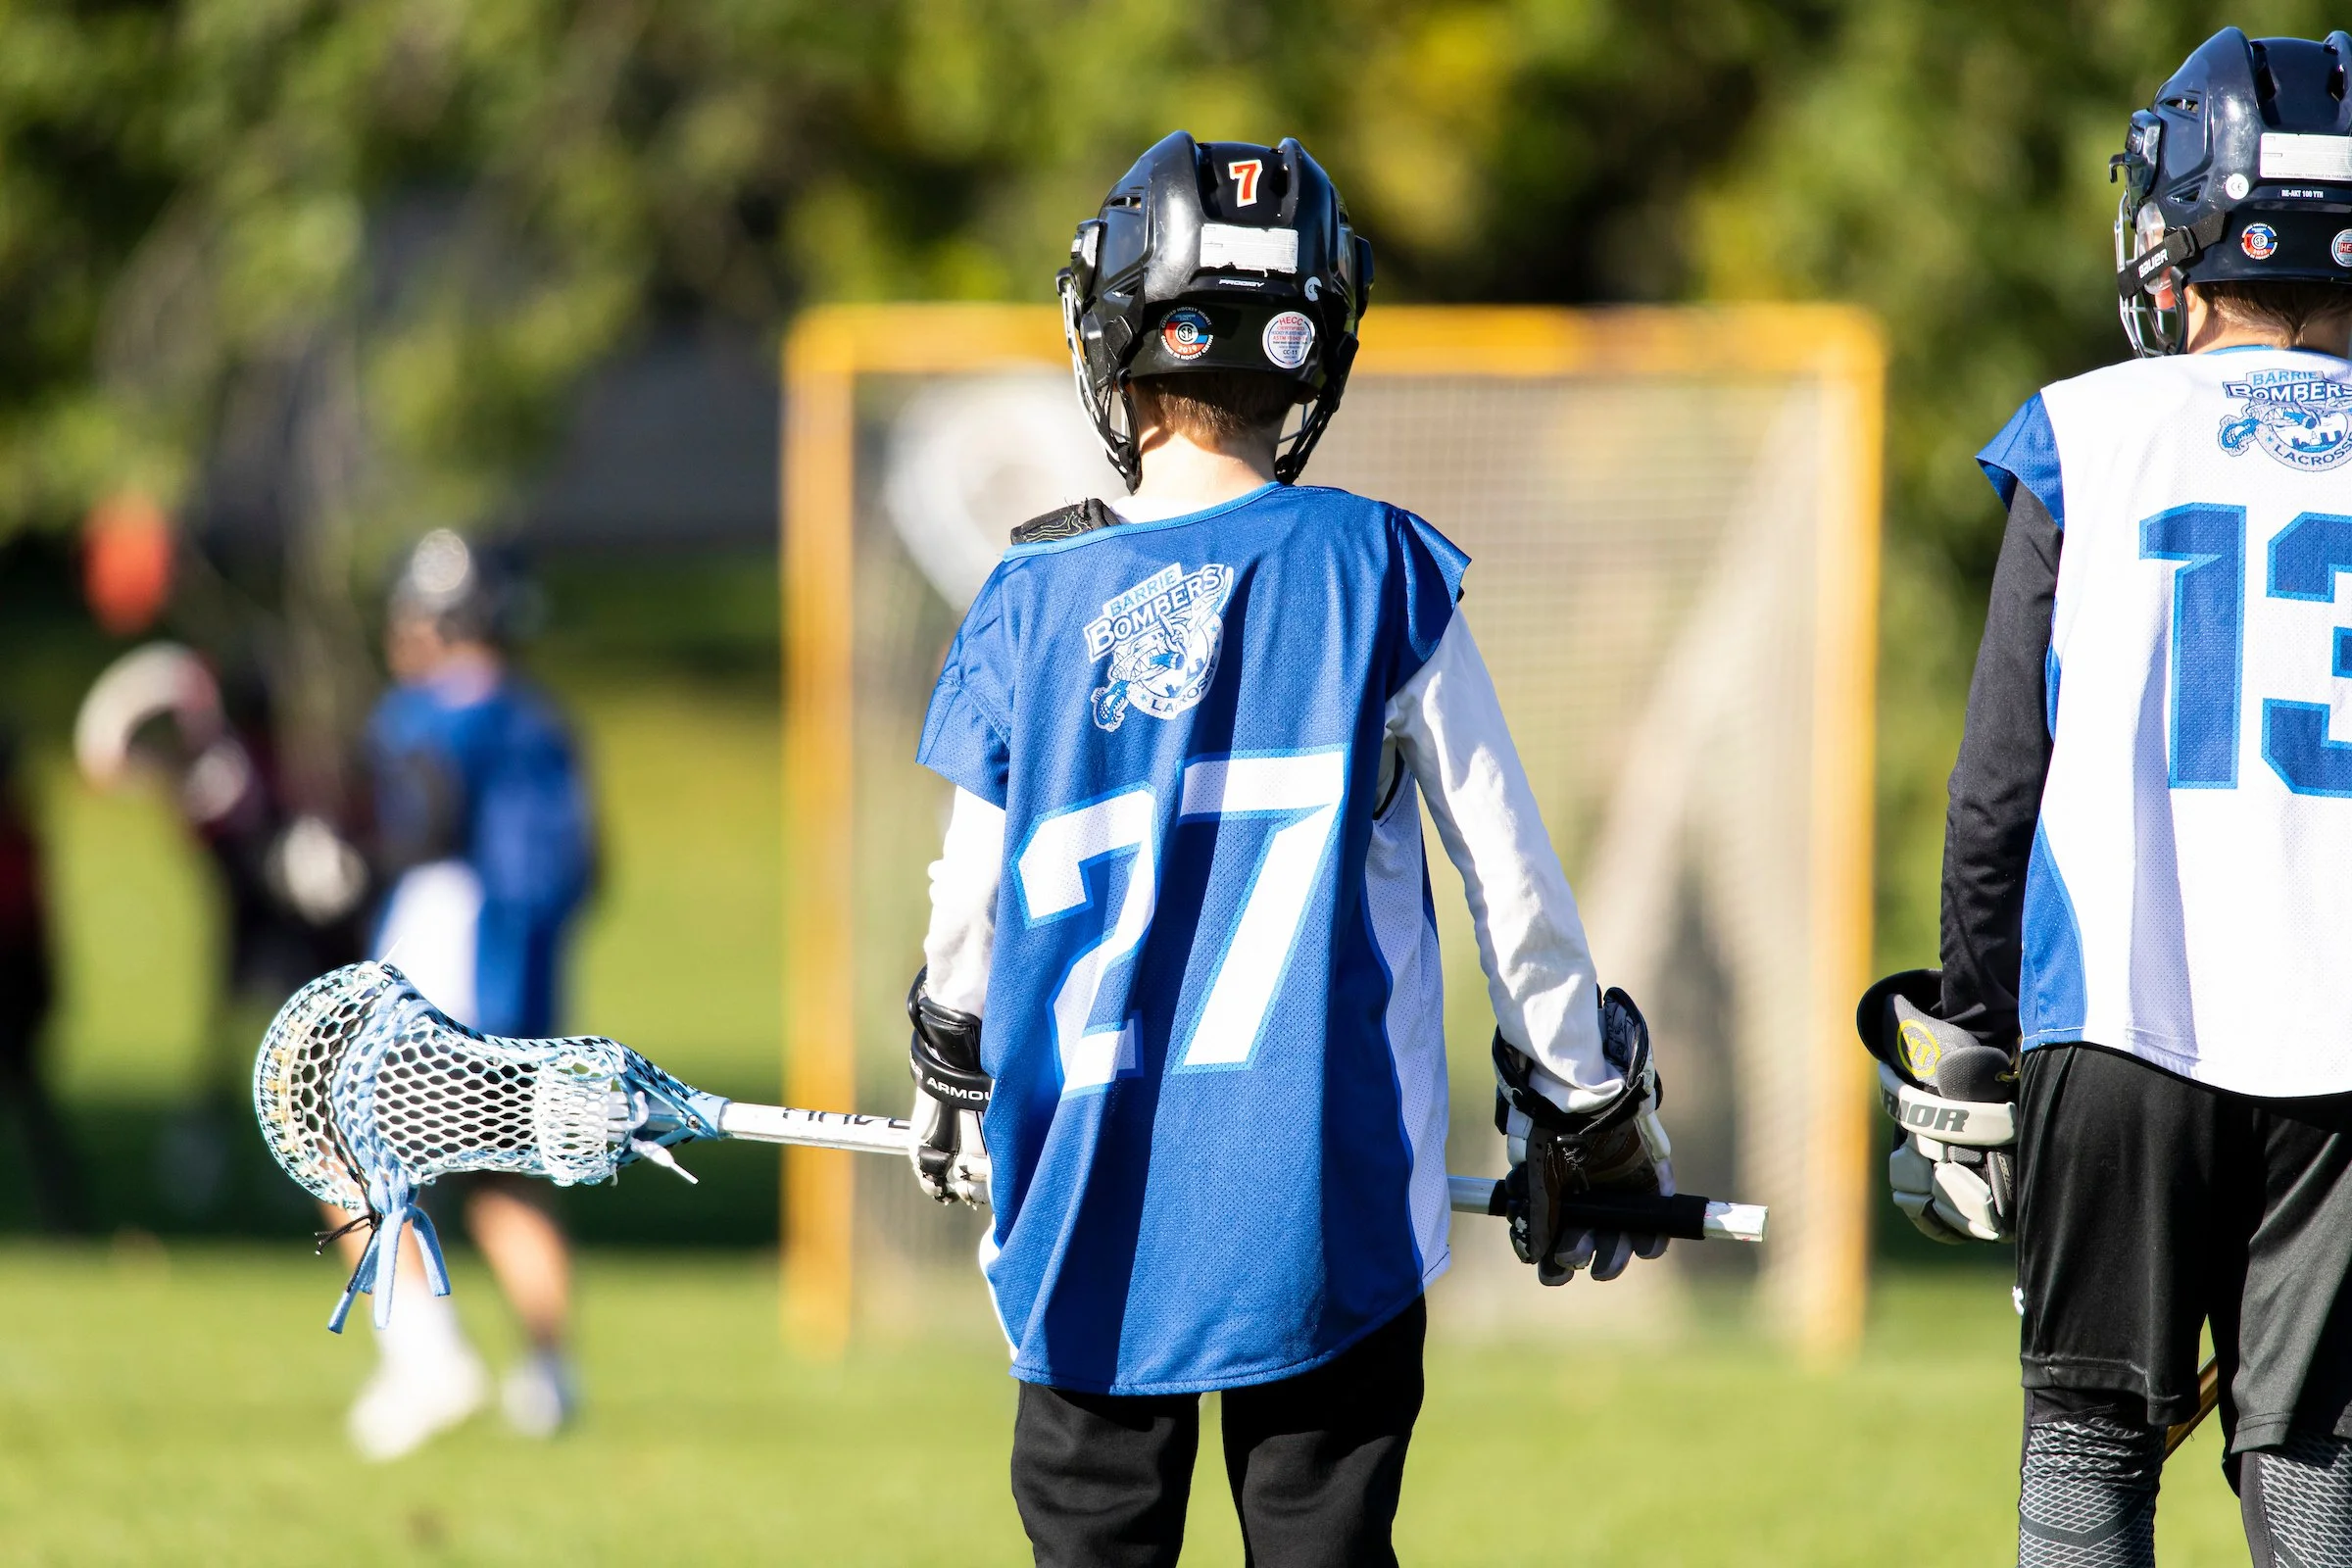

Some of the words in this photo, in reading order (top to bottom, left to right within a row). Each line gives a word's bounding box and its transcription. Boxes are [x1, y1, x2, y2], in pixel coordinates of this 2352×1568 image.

[1228, 159, 1264, 208] 7
[2230, 181, 2243, 192] CE
[2341, 243, 2352, 252] HE
[2137, 248, 2169, 279] BAUER
[1218, 278, 1265, 288] PRODIGY
[1198, 310, 1212, 325] HELMET
[1279, 317, 1303, 325] HECC
[1177, 345, 1198, 354] 2019
[2252, 370, 2319, 386] BARRIE
[1109, 569, 1178, 616] BARRIE
[1089, 564, 1225, 659] BOMBERS
[2139, 502, 2352, 799] 13
[1010, 742, 1352, 1102] 27
[1881, 1086, 1970, 1132] RIOR
